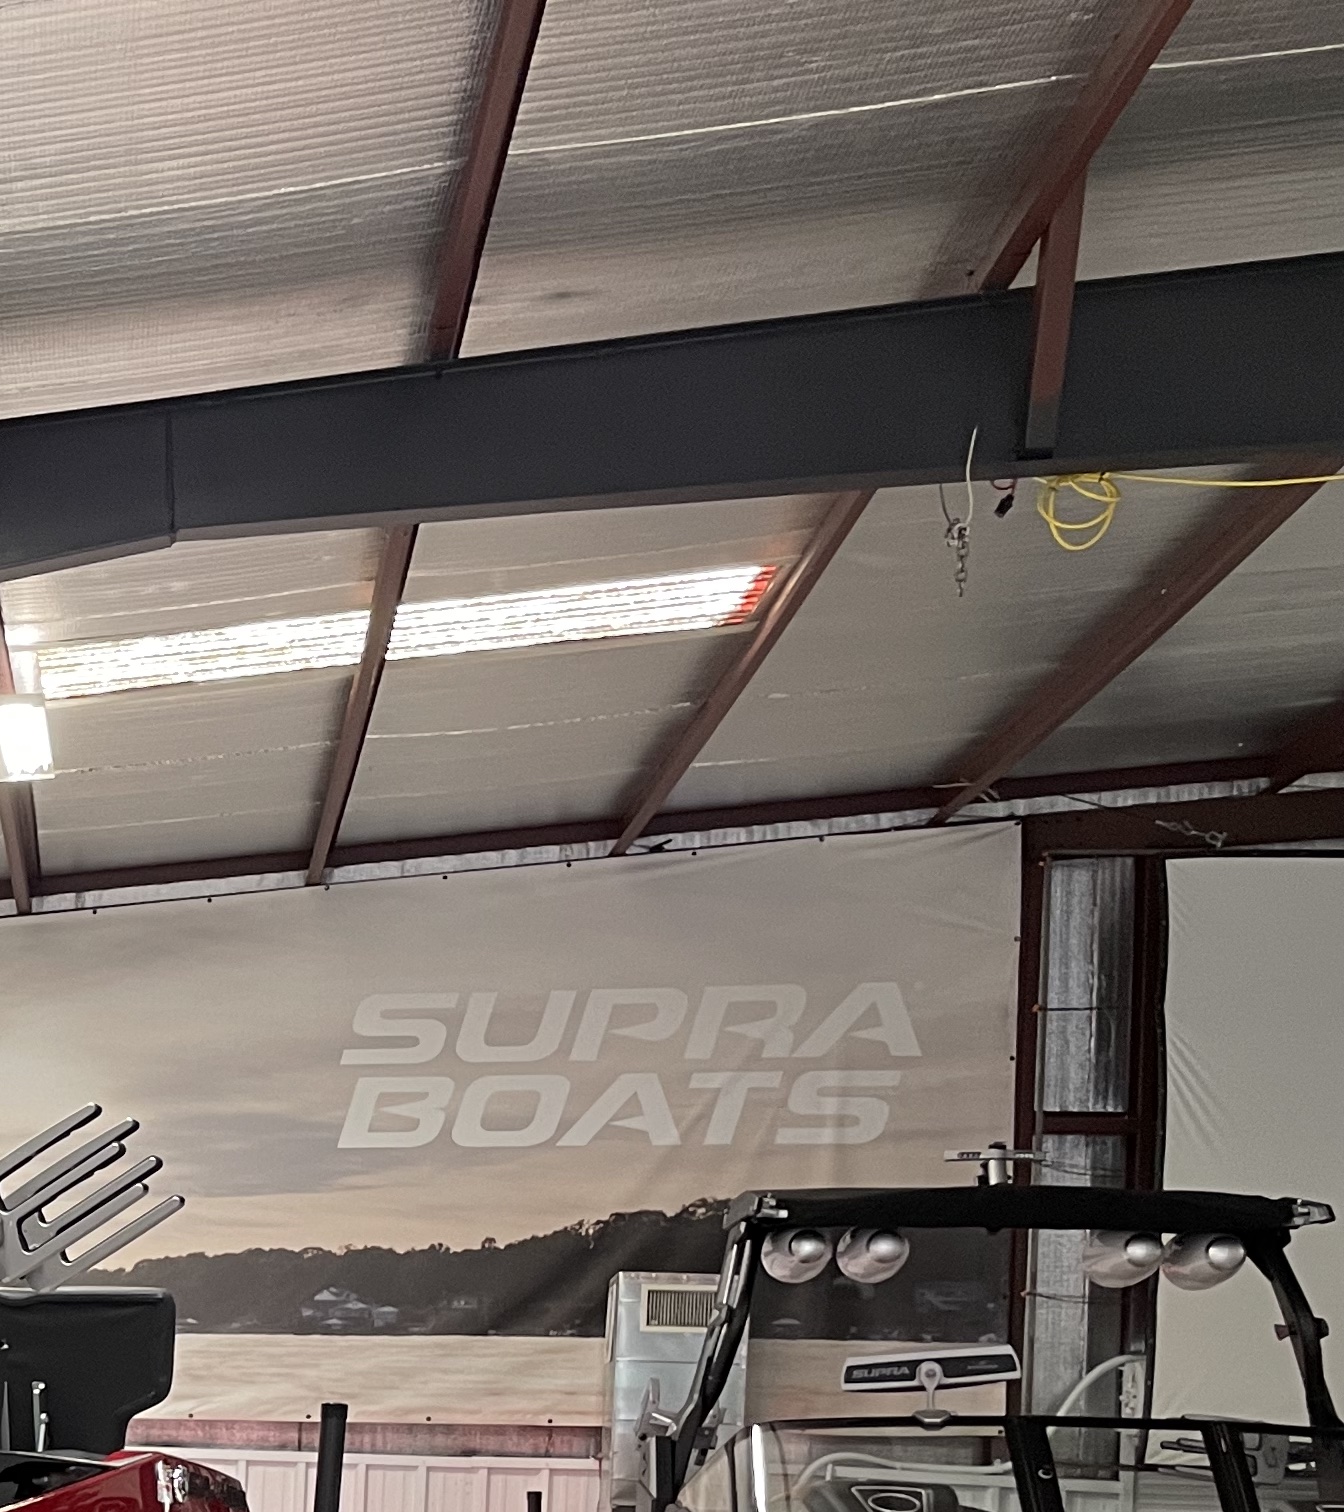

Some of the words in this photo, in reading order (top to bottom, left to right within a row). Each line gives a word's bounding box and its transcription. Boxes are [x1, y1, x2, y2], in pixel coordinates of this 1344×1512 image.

[339, 981, 923, 1066] SUPRA
[337, 1069, 903, 1149] BOATS
[851, 1365, 911, 1380] SUPRA
